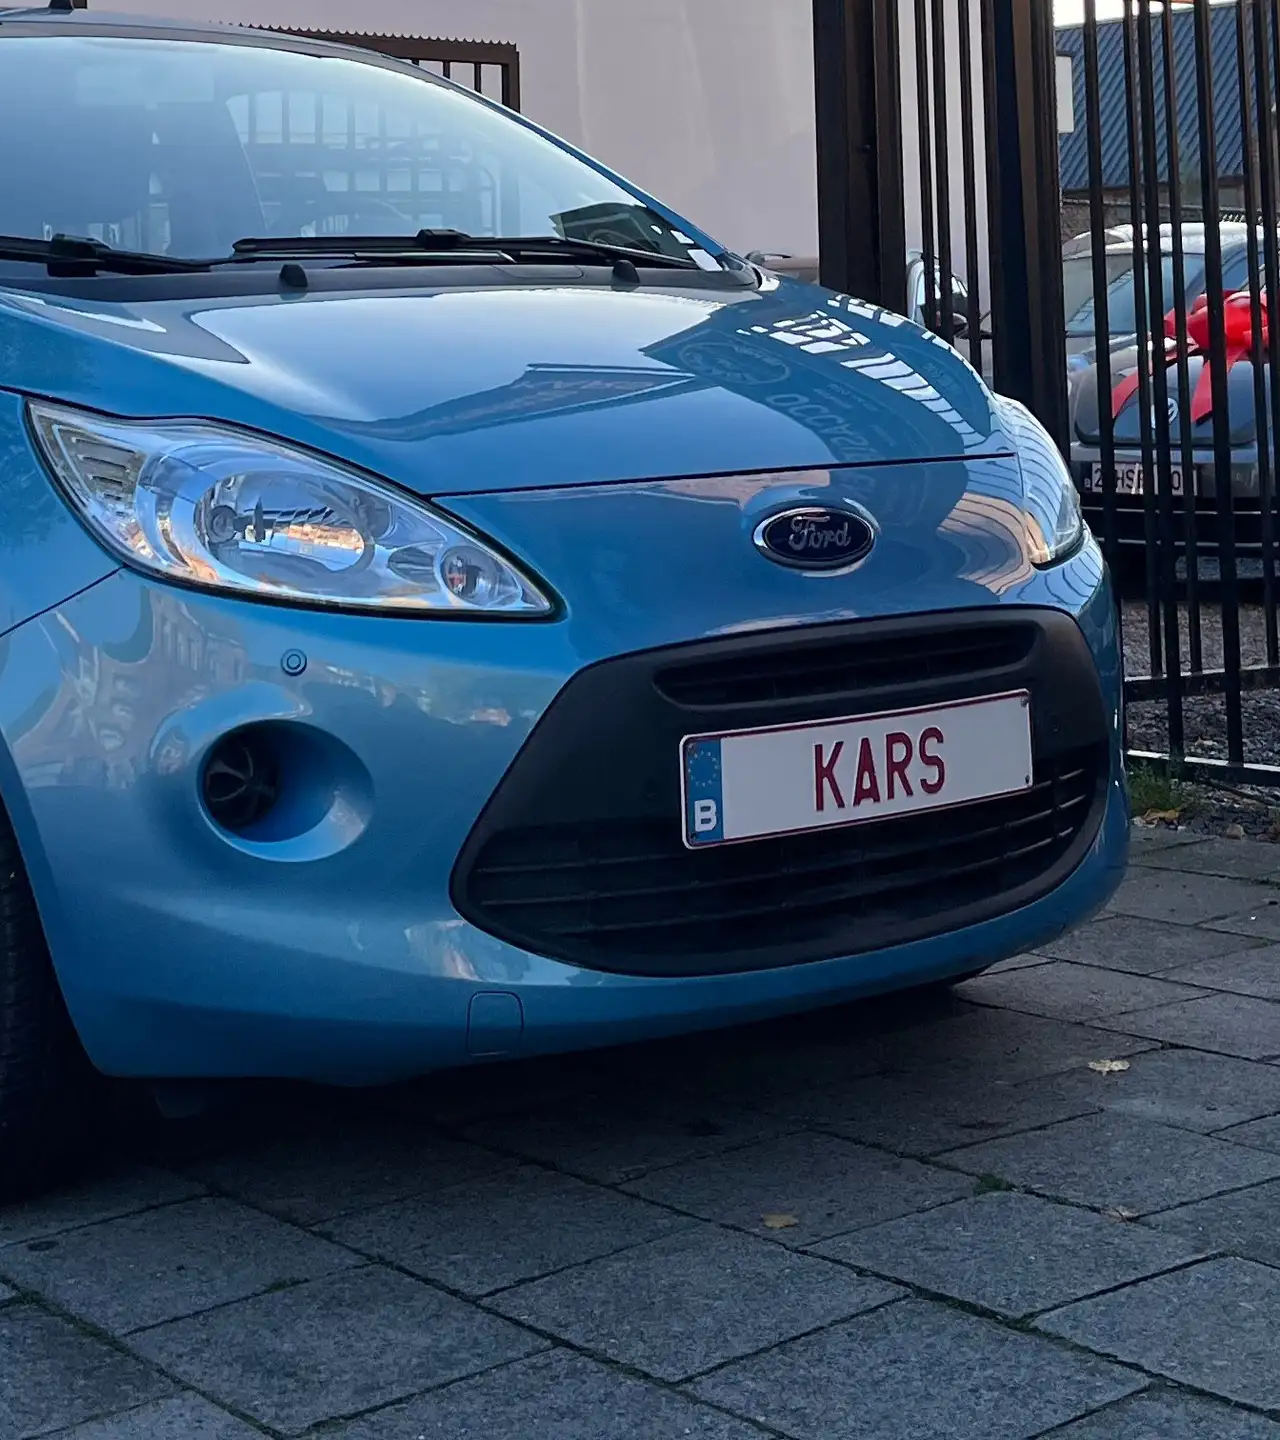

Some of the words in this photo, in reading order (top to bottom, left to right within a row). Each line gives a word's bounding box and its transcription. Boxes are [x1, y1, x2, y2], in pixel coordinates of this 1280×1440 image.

[788, 515, 852, 550] Ford
[814, 726, 946, 812] KARS
[694, 798, 717, 832] B
